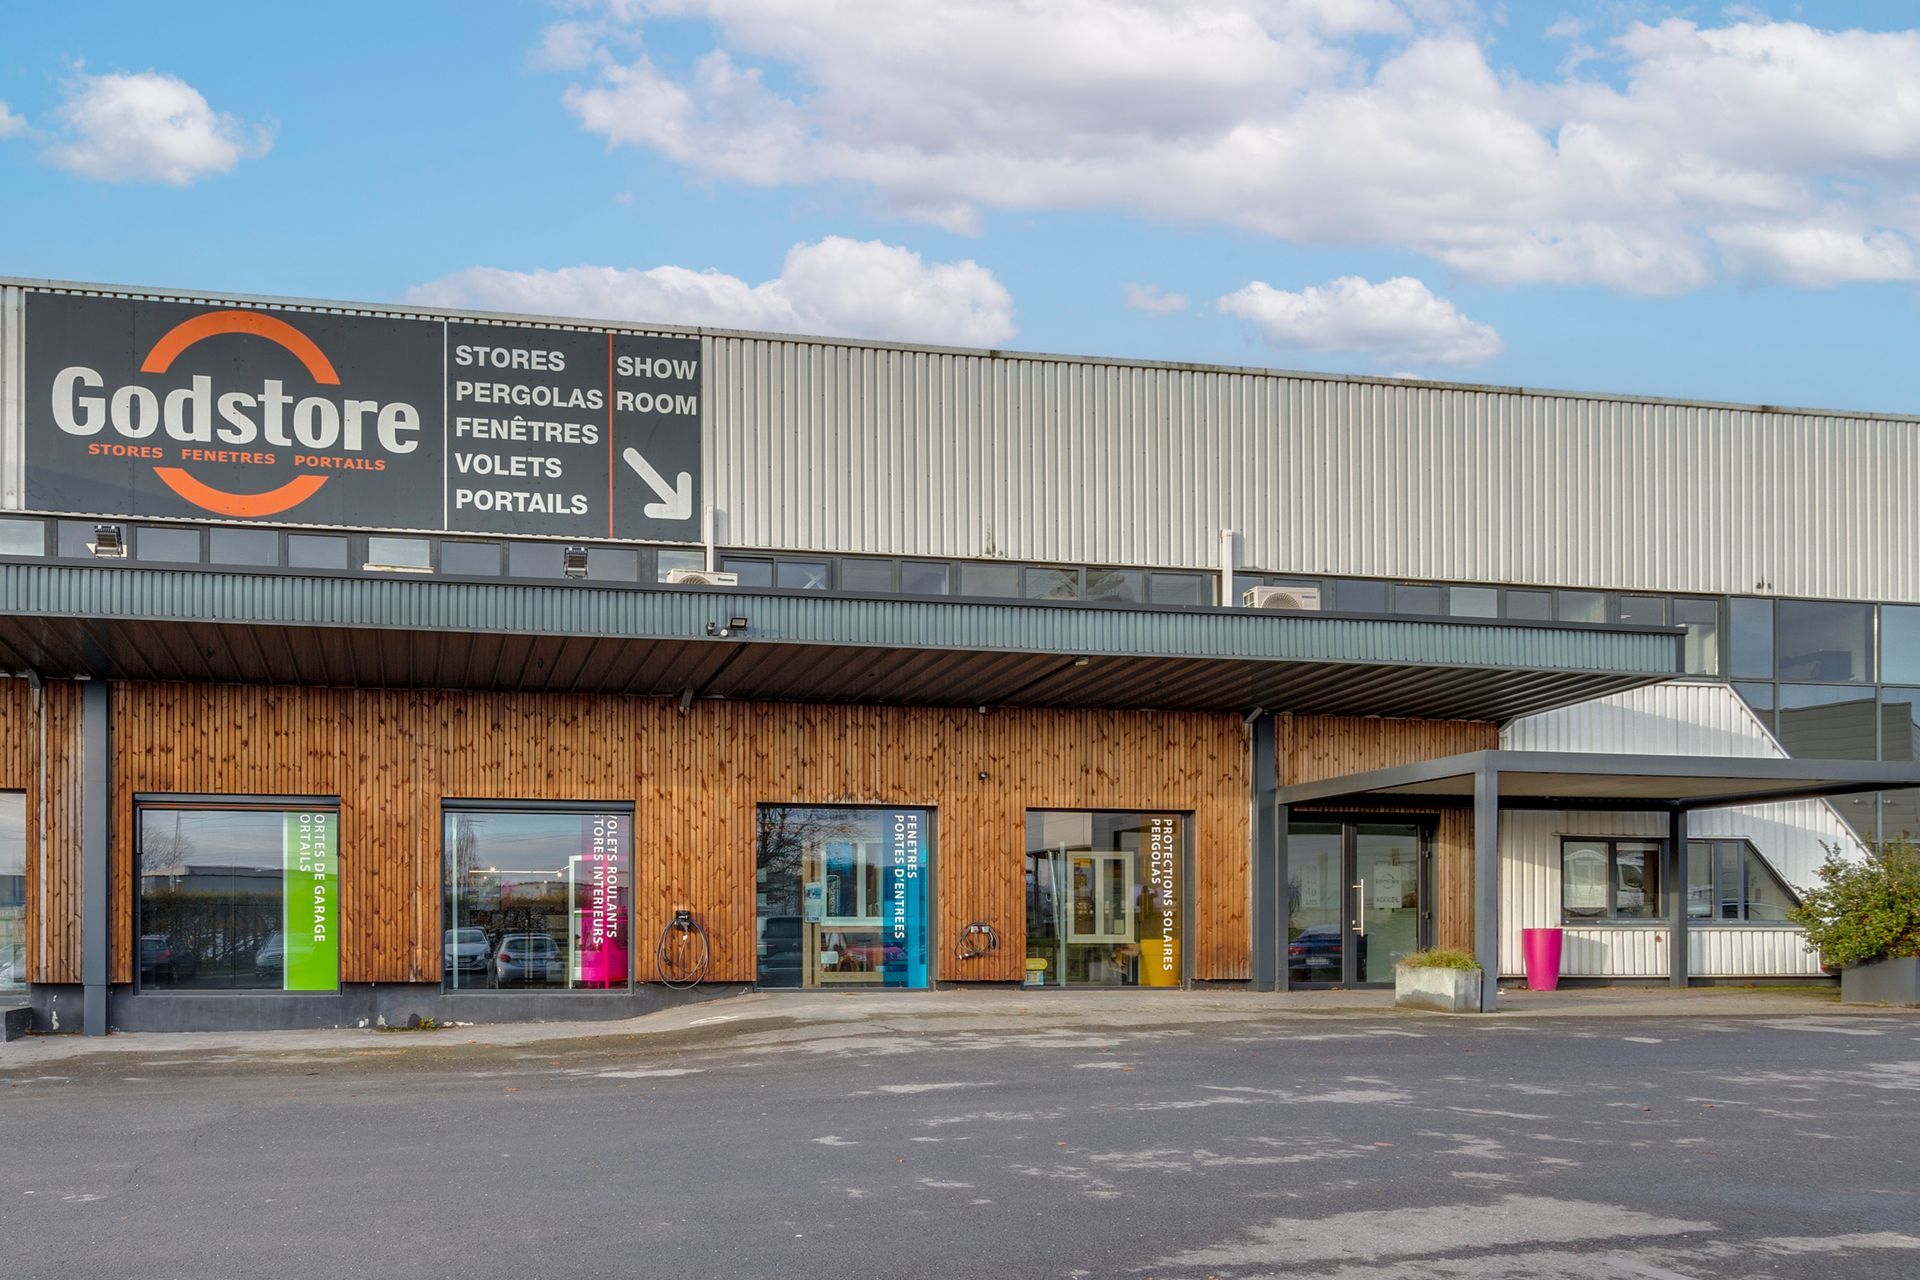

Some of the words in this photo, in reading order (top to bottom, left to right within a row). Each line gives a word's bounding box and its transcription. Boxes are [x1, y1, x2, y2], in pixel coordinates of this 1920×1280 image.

[455, 345, 566, 372] STORES
[616, 355, 698, 380] SHOW
[52, 366, 420, 454] Godstore
[456, 380, 604, 410] PERGOLAS
[616, 390, 697, 416] ROOM
[456, 415, 599, 445] FENÊTRES
[89, 443, 163, 459] STORES
[181, 448, 276, 465] FENETRES
[294, 455, 386, 471] PORTAILS
[455, 452, 563, 479] VOLETS
[455, 488, 589, 515] PORTAILS
[300, 814, 311, 872] ORTAILS
[314, 814, 326, 858] ORTES
[593, 815, 604, 861] TORES
[894, 815, 905, 864] PORTES
[907, 815, 917, 878] FENETRES
[1151, 819, 1161, 884] PERGOLAS
[314, 863, 326, 881] DE
[1163, 819, 1173, 906] PROTECTIONS
[314, 885, 326, 942] GARAGE
[593, 866, 604, 944] INTERIEURS
[606, 867, 618, 938] ROULANTS
[1163, 910, 1173, 971] SOLAIRES
